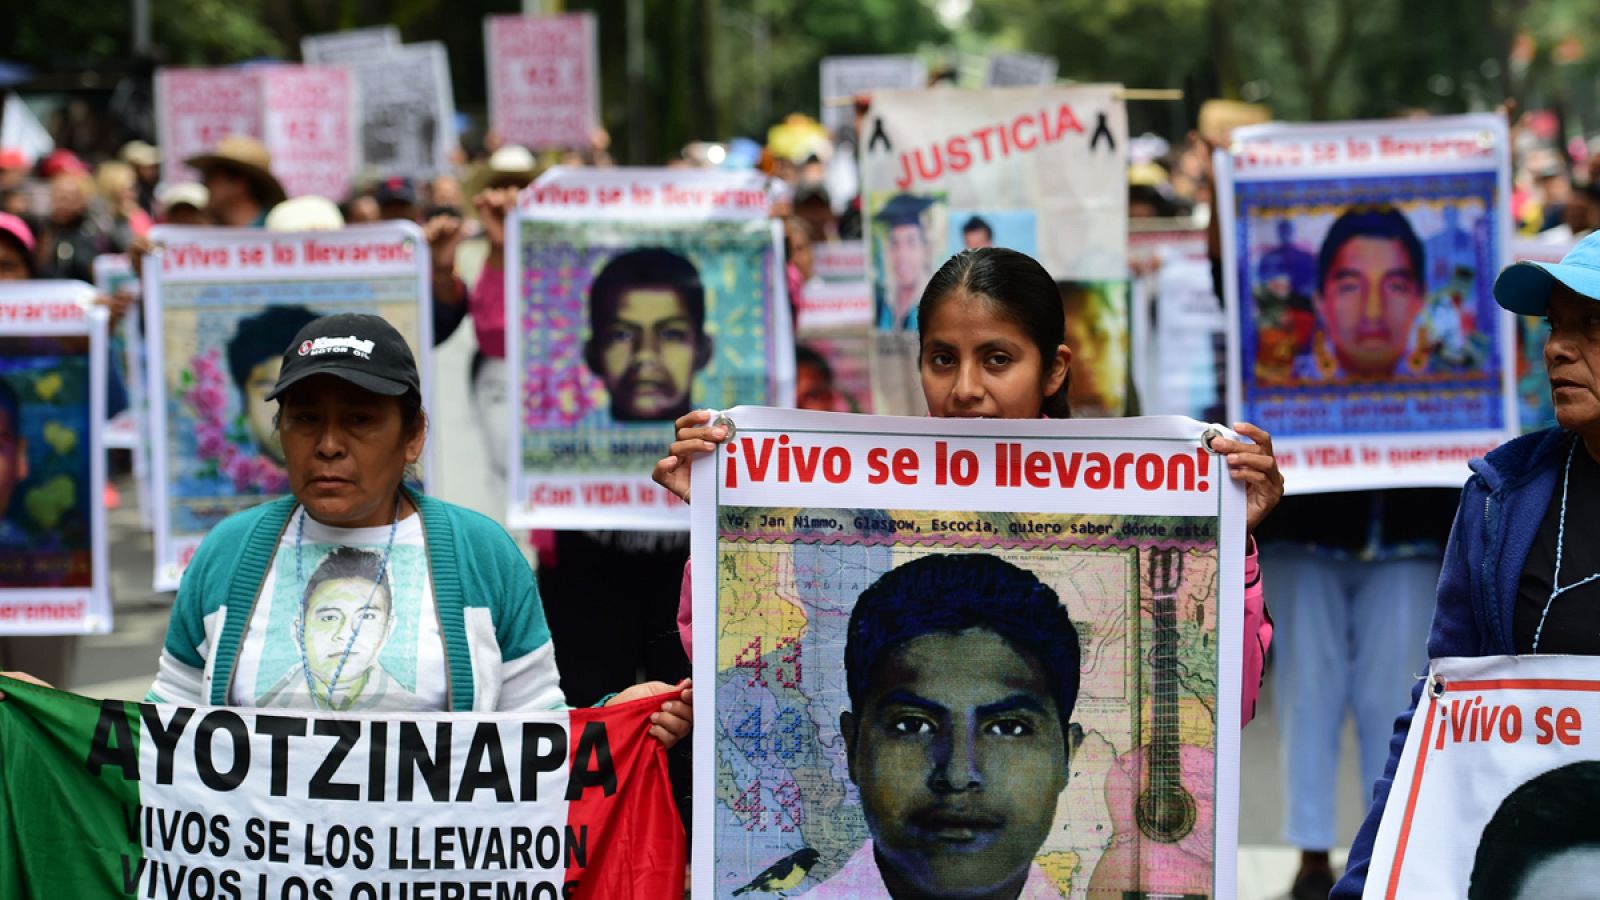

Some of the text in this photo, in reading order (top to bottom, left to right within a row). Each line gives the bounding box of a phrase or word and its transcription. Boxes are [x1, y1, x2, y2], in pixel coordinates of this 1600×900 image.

[896, 103, 1085, 190] JUSTICIA
[1313, 144, 1337, 162] se
[1347, 136, 1372, 159] lo
[596, 185, 621, 205] se
[630, 180, 653, 204] lo
[239, 247, 263, 266] se
[273, 240, 294, 265] lo
[310, 347, 370, 360] MOTOR OIL
[725, 434, 1210, 492] ¡Vivo se lo llevaron!
[1304, 442, 1354, 467] VIDA
[1361, 440, 1379, 464] lo
[1389, 442, 1495, 472] queremos
[580, 482, 630, 506] VIDA
[638, 483, 656, 506] lo
[727, 514, 1210, 537] Yo, Jan Nimmo, Glasgow, Escocia, quiero saber dónde está
[735, 636, 802, 688] 43
[733, 705, 801, 760] 43
[1435, 695, 1582, 750] ¡Vivo se
[87, 699, 617, 801] AYOTZINAPA
[733, 780, 801, 832] 43
[122, 802, 588, 870] VIVOS SE LOS LLEVARON
[120, 854, 241, 900] VIVOS
